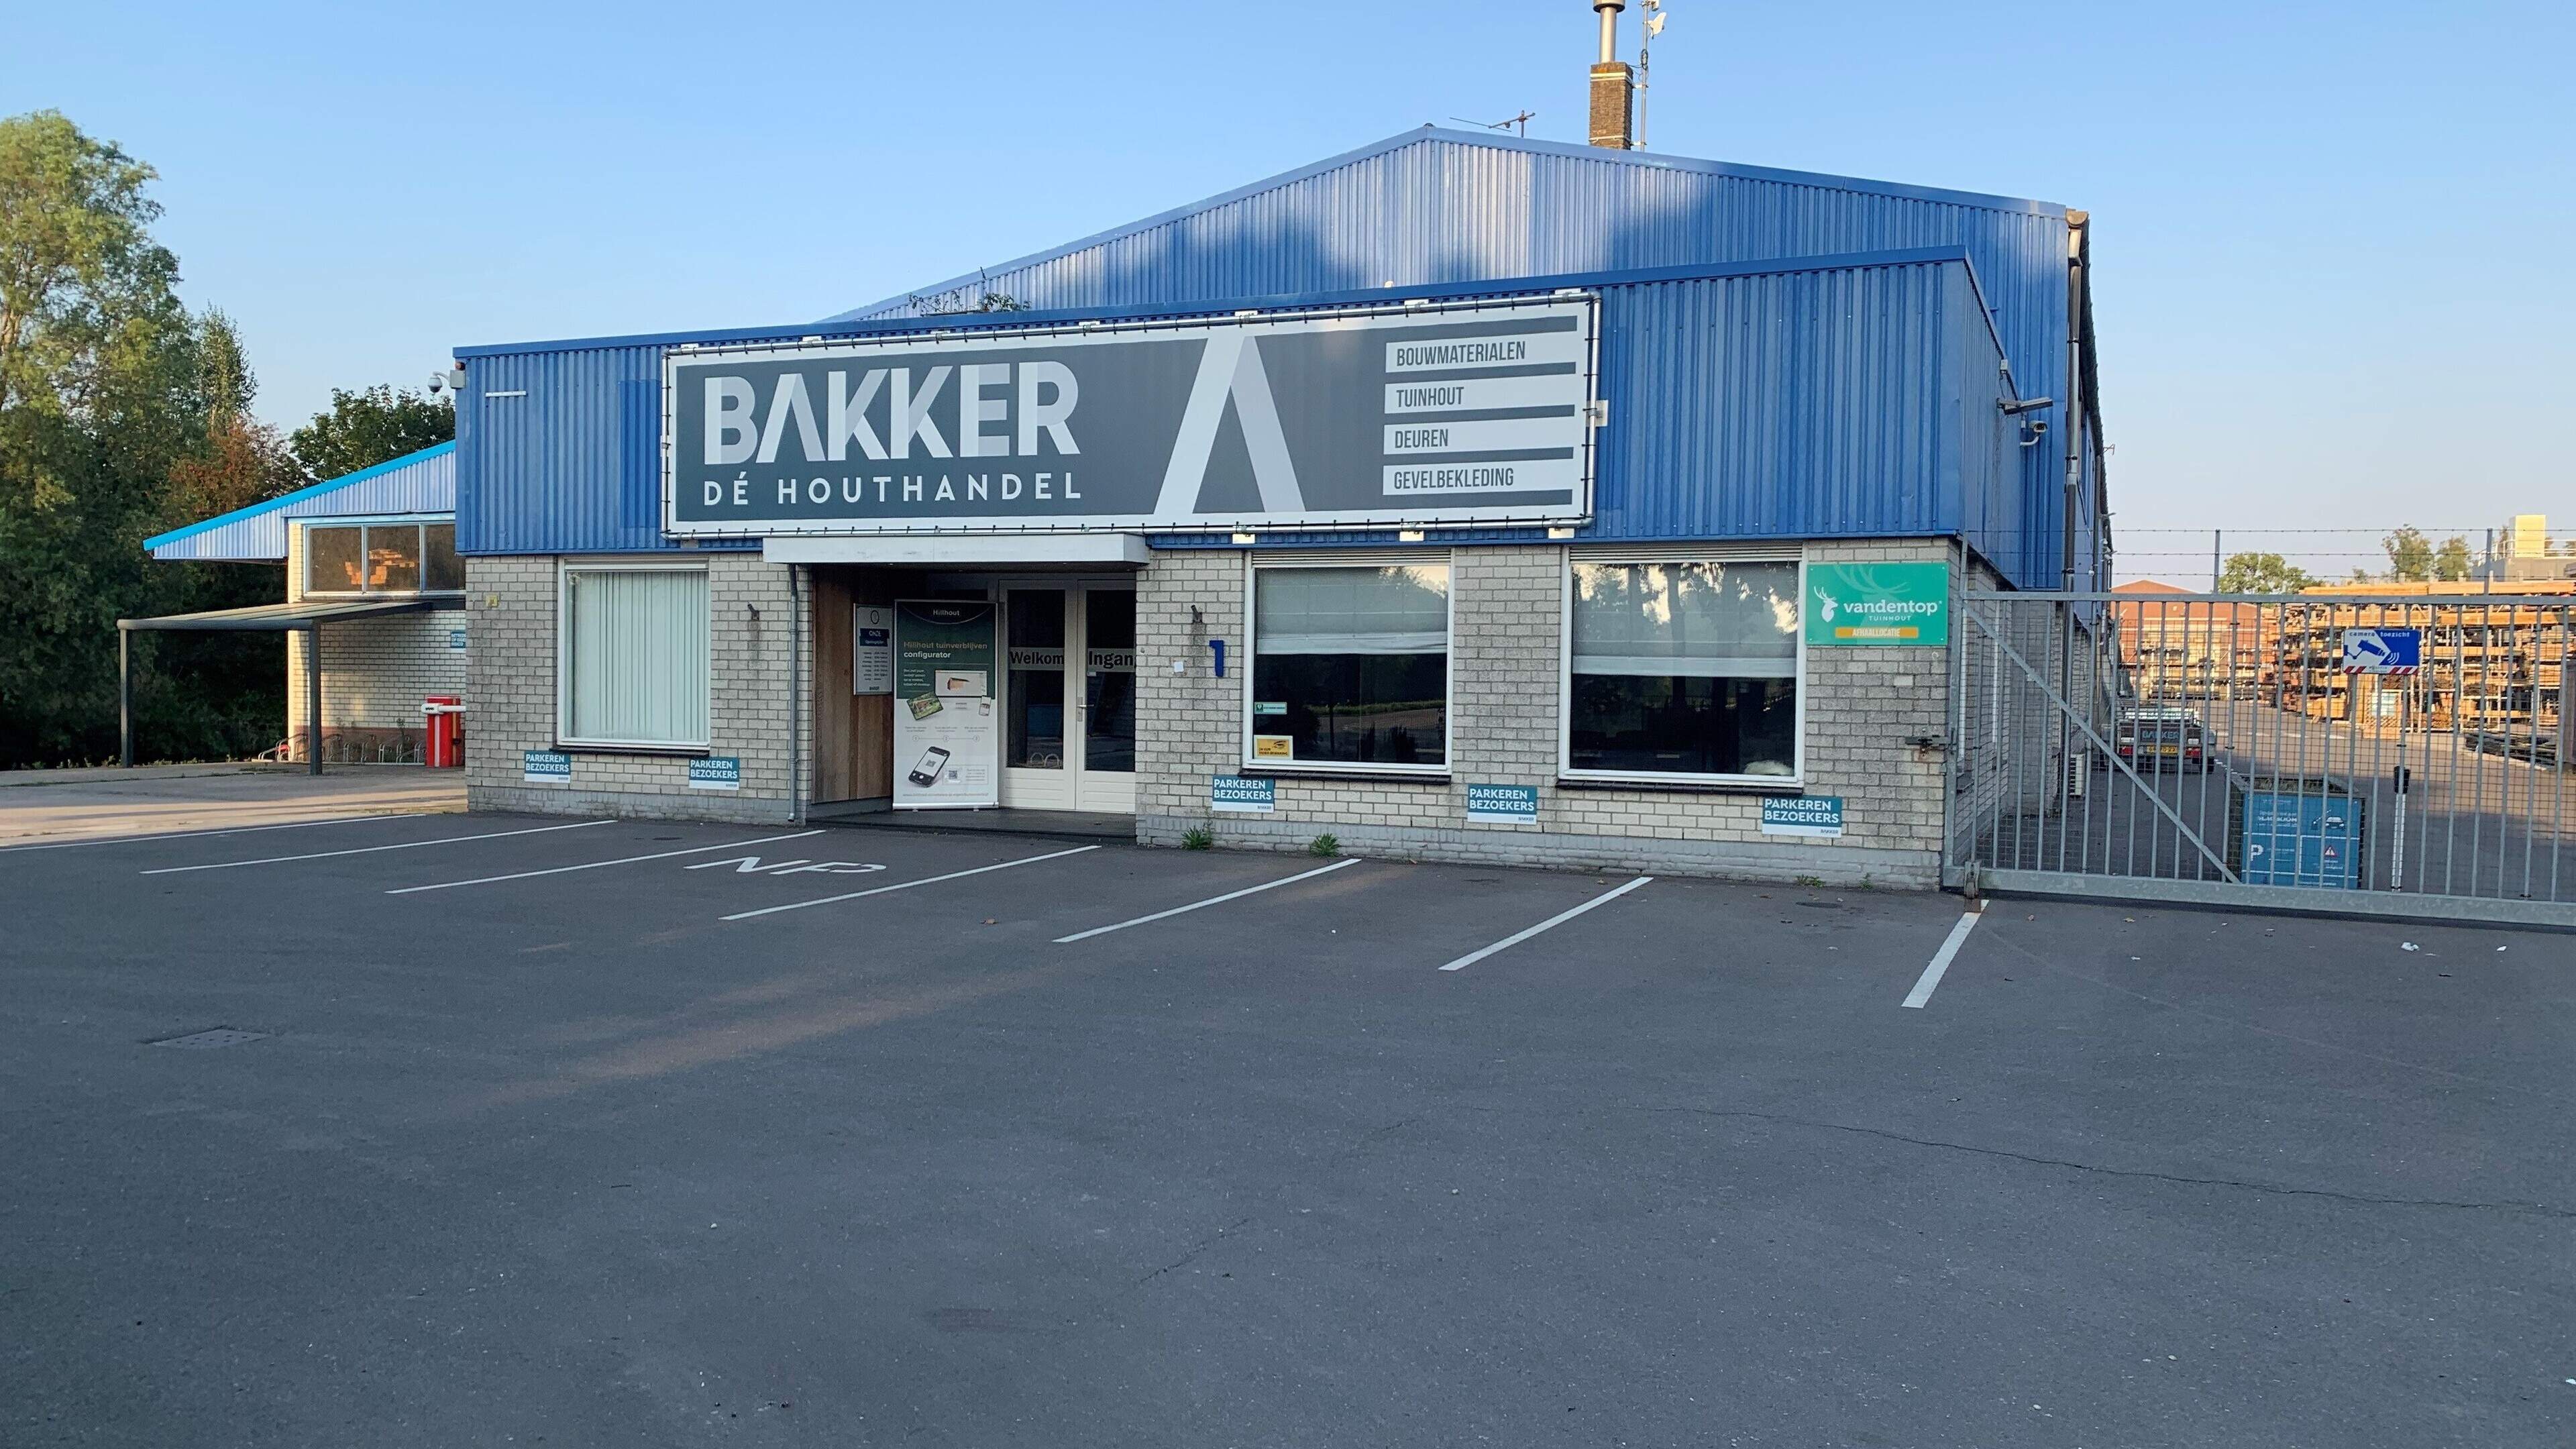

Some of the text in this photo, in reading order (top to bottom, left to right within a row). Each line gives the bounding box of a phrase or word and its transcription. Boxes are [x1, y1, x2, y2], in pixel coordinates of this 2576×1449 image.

[1396, 341, 1526, 367] BOUWMATERIALEN
[1396, 386, 1464, 408] TUINHOUT
[704, 360, 1081, 465] BAKKER
[1394, 429, 1449, 449] DEUREN
[1393, 468, 1514, 489] GEVELBEKLEDING
[704, 472, 1081, 506] DÉ HOUTHANDEL
[1843, 599, 1938, 616] vandentop
[1851, 627, 1900, 637] AFHAALLOCATIE
[936, 642, 987, 650] tuinverblijven
[903, 651, 951, 659] configurator
[1010, 651, 1065, 665] Welkom
[1089, 651, 1136, 669] Ingan
[1209, 639, 1224, 677] 1
[525, 753, 565, 763] PARKEREN
[690, 759, 733, 769] PARKEREN
[525, 763, 570, 772] BEZOEKERS
[690, 769, 738, 779] BEZOEKERS
[1214, 779, 1266, 790] PARKEREN
[1214, 789, 1272, 800] BEZOEKERS
[1470, 788, 1527, 800] PARKEREN
[1469, 800, 1535, 812] BEZOEKERS
[1764, 798, 1832, 811] PARKEREN
[1764, 810, 1839, 823] BEZOEKERS
